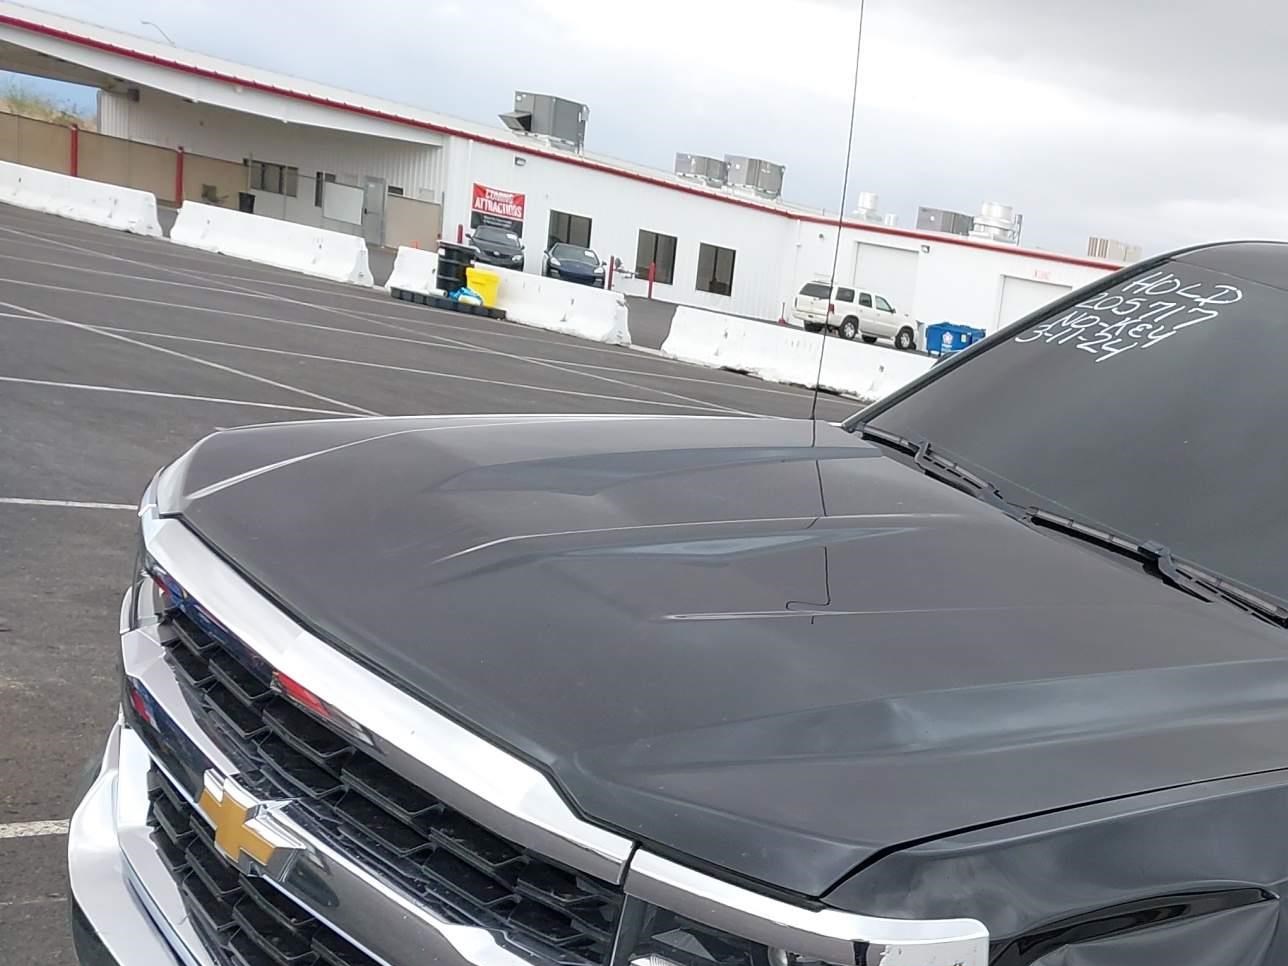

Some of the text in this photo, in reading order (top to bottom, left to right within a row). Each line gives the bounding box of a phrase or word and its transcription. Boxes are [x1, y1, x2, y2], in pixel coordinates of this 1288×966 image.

[474, 197, 522, 217] ATTRACTIONS
[1122, 271, 1244, 306] HOLD
[1014, 323, 1138, 363] 3-11-24
